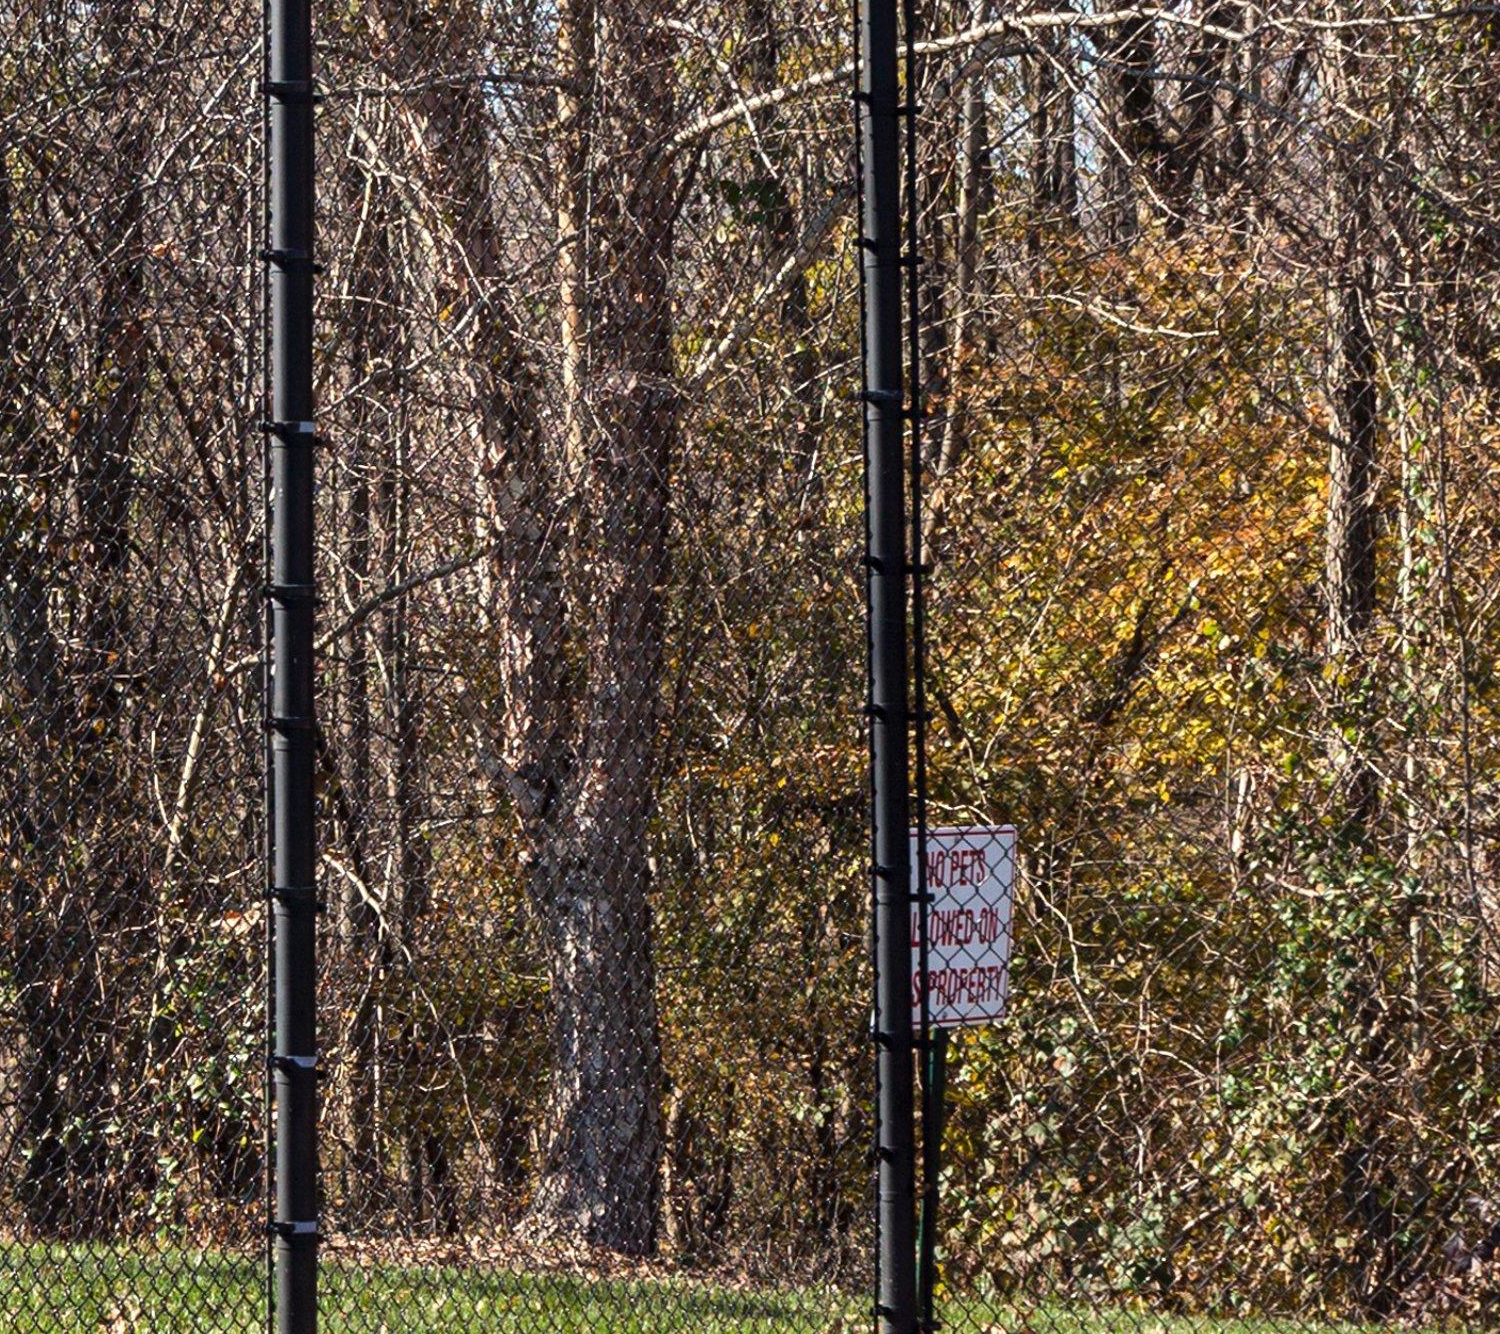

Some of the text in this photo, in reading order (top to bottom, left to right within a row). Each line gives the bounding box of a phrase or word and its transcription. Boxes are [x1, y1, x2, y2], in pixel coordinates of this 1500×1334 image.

[926, 849, 986, 888] NO PETS
[979, 907, 999, 944] ON
